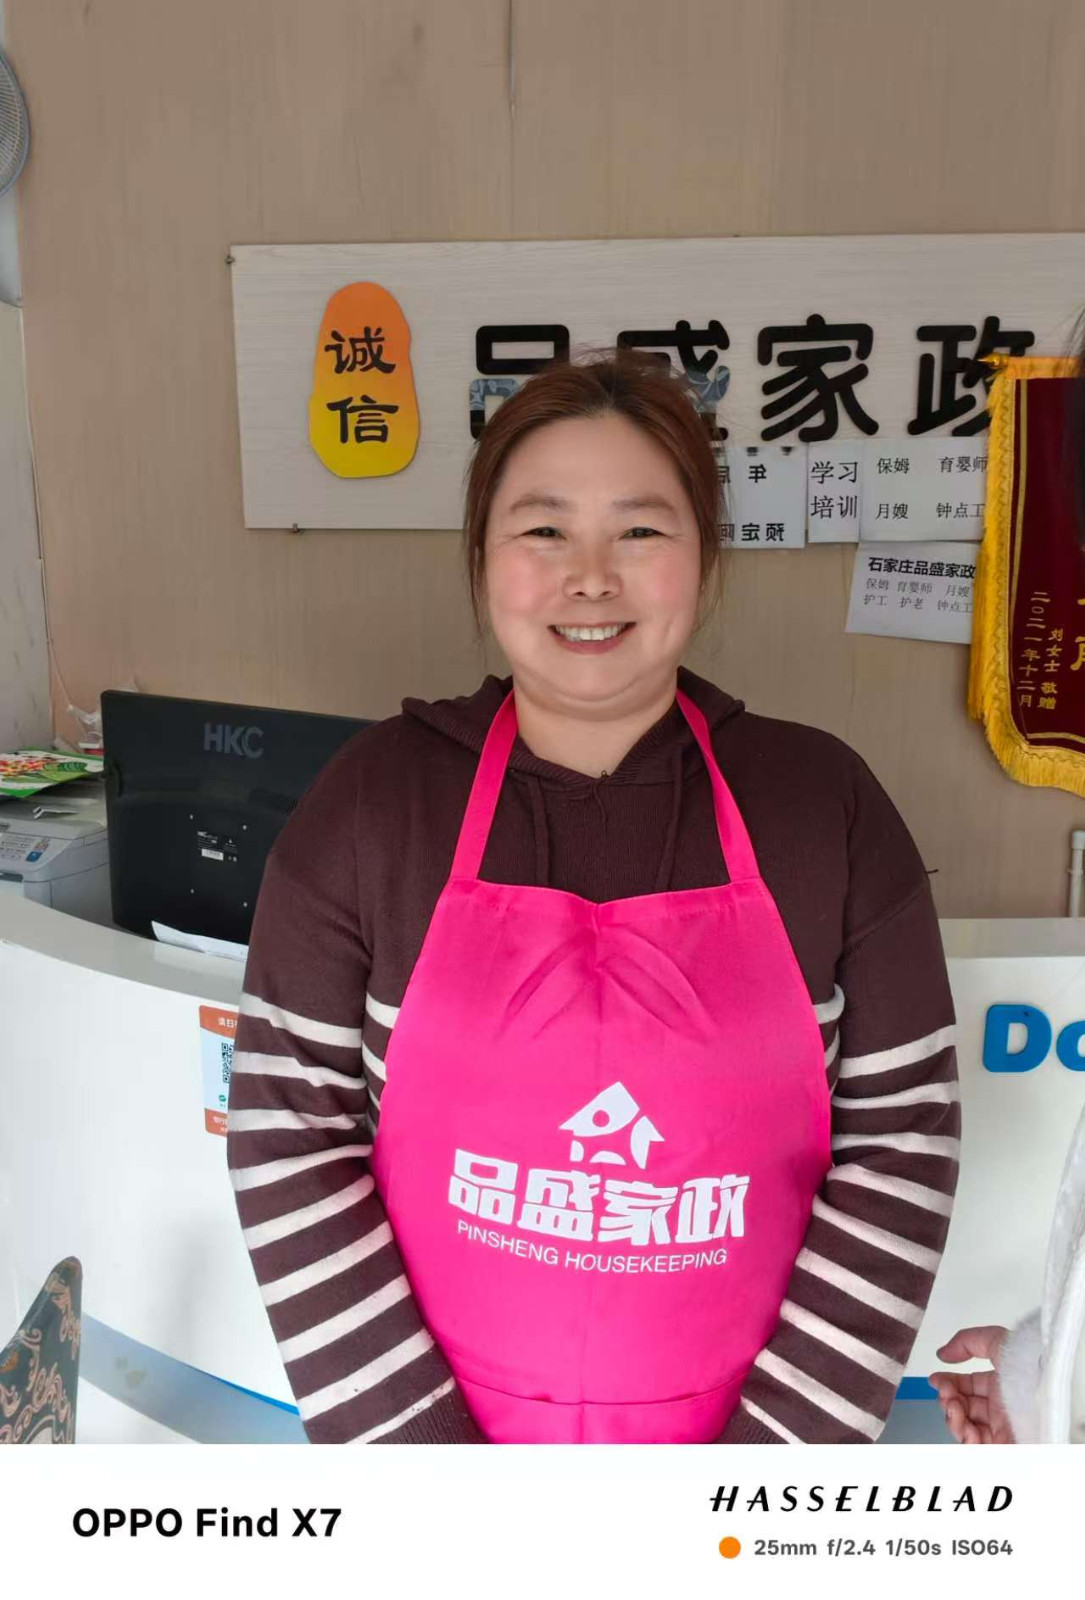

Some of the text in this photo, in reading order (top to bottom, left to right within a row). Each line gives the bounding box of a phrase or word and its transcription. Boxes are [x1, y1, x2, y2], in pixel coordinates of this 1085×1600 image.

[324, 325, 399, 444] 诚信
[810, 461, 858, 484] 学习
[877, 456, 988, 474] 保姆 育婴师
[810, 495, 858, 519] 培训
[875, 502, 986, 520] 月嫂 钟点工
[868, 556, 977, 579] 石家庄品盛家政
[203, 723, 264, 759] HKC
[448, 1148, 750, 1246] 品盛家政
[456, 1219, 728, 1273] PINSHENG HOUSEKEEPING
